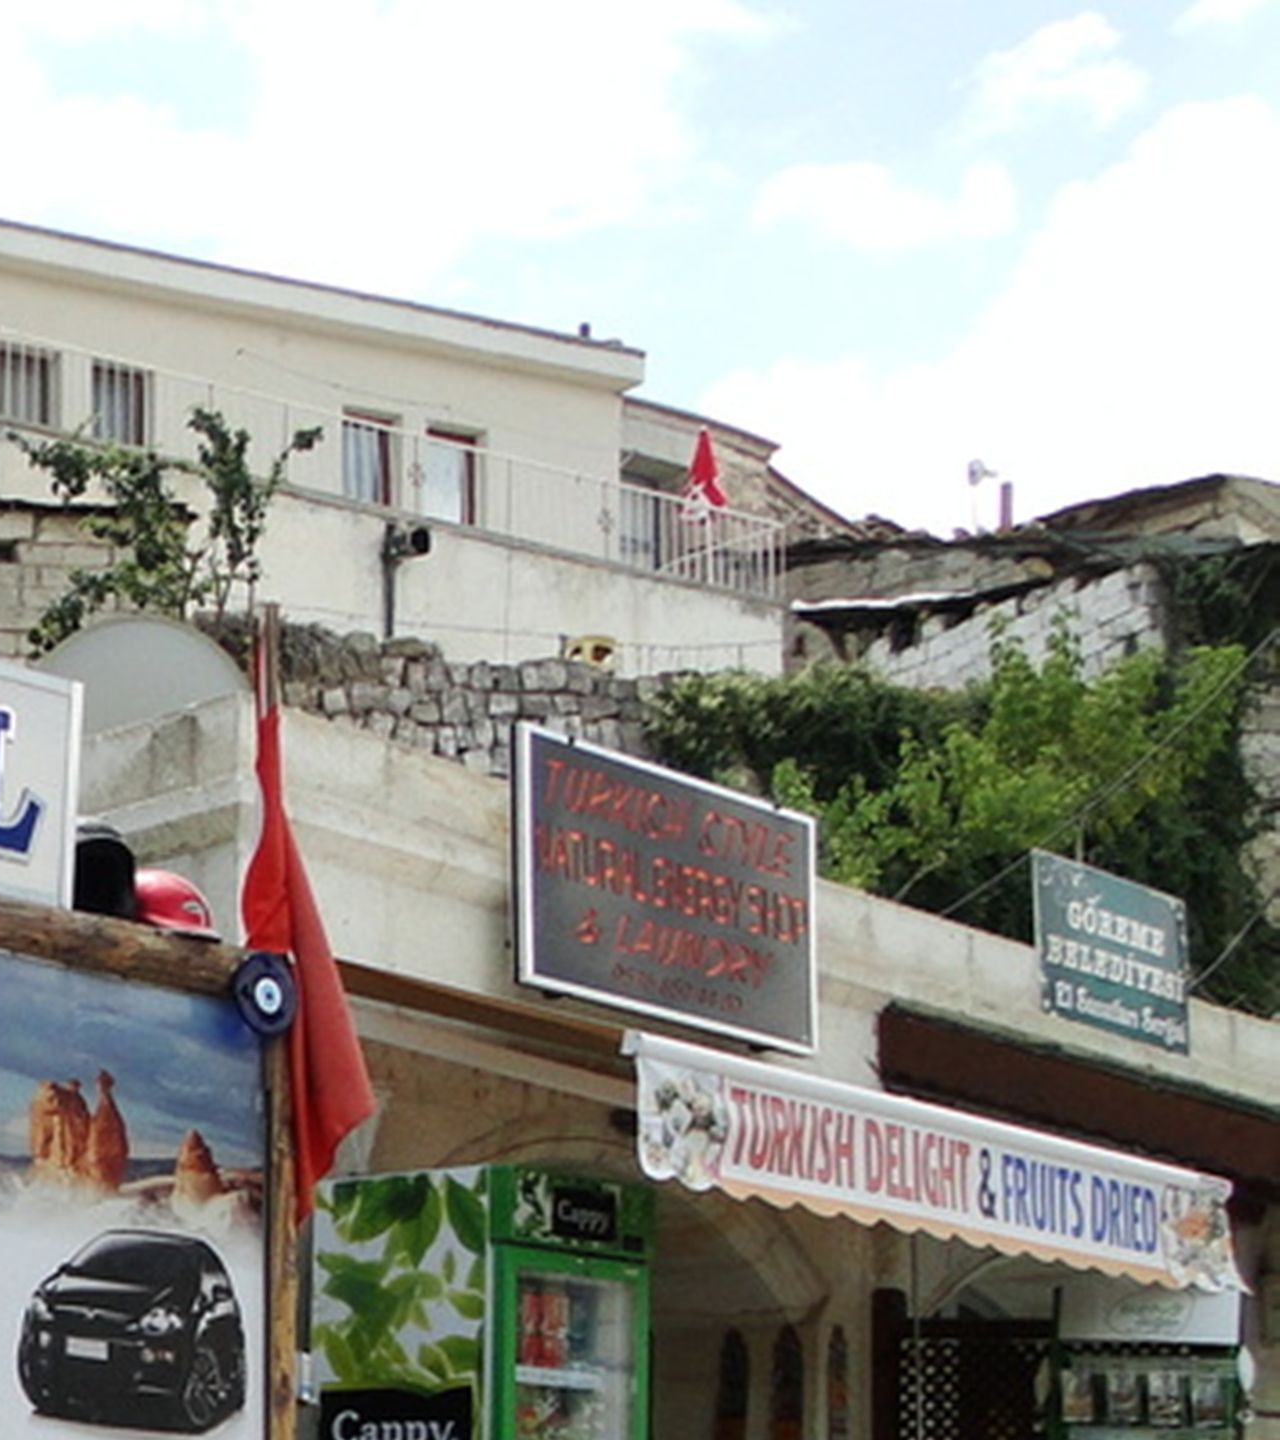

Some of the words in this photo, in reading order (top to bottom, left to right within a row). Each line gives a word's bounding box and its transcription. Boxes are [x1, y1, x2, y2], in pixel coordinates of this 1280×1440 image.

[575, 907, 601, 944] &
[613, 913, 777, 988] LAUNDRY
[729, 1086, 856, 1190] TURKISH
[863, 1116, 971, 1214] DELIGHT
[977, 1148, 997, 1219] &
[1000, 1153, 1084, 1239] FRUITS
[1090, 1175, 1159, 1255] DRIED
